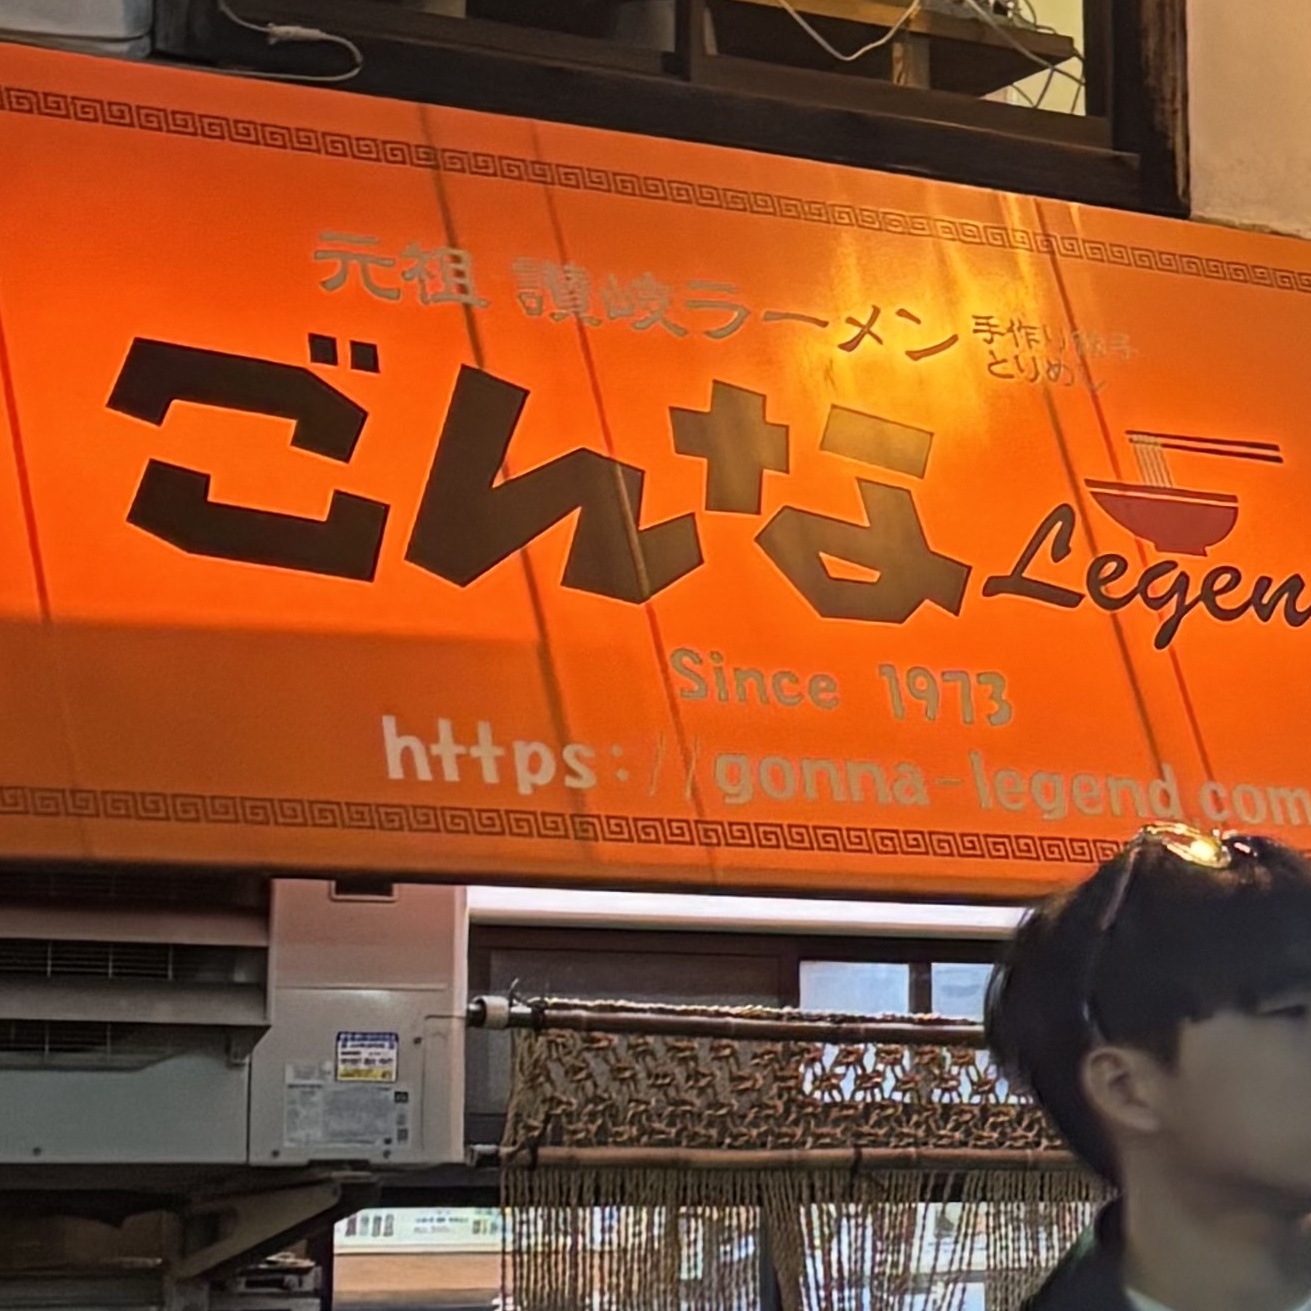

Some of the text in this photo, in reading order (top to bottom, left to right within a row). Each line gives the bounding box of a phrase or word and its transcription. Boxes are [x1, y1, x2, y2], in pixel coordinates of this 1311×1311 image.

[312, 230, 959, 362] 元祖 讃岐ラーメン
[105, 332, 972, 624] ごんな
[670, 648, 1014, 727] Since 1973
